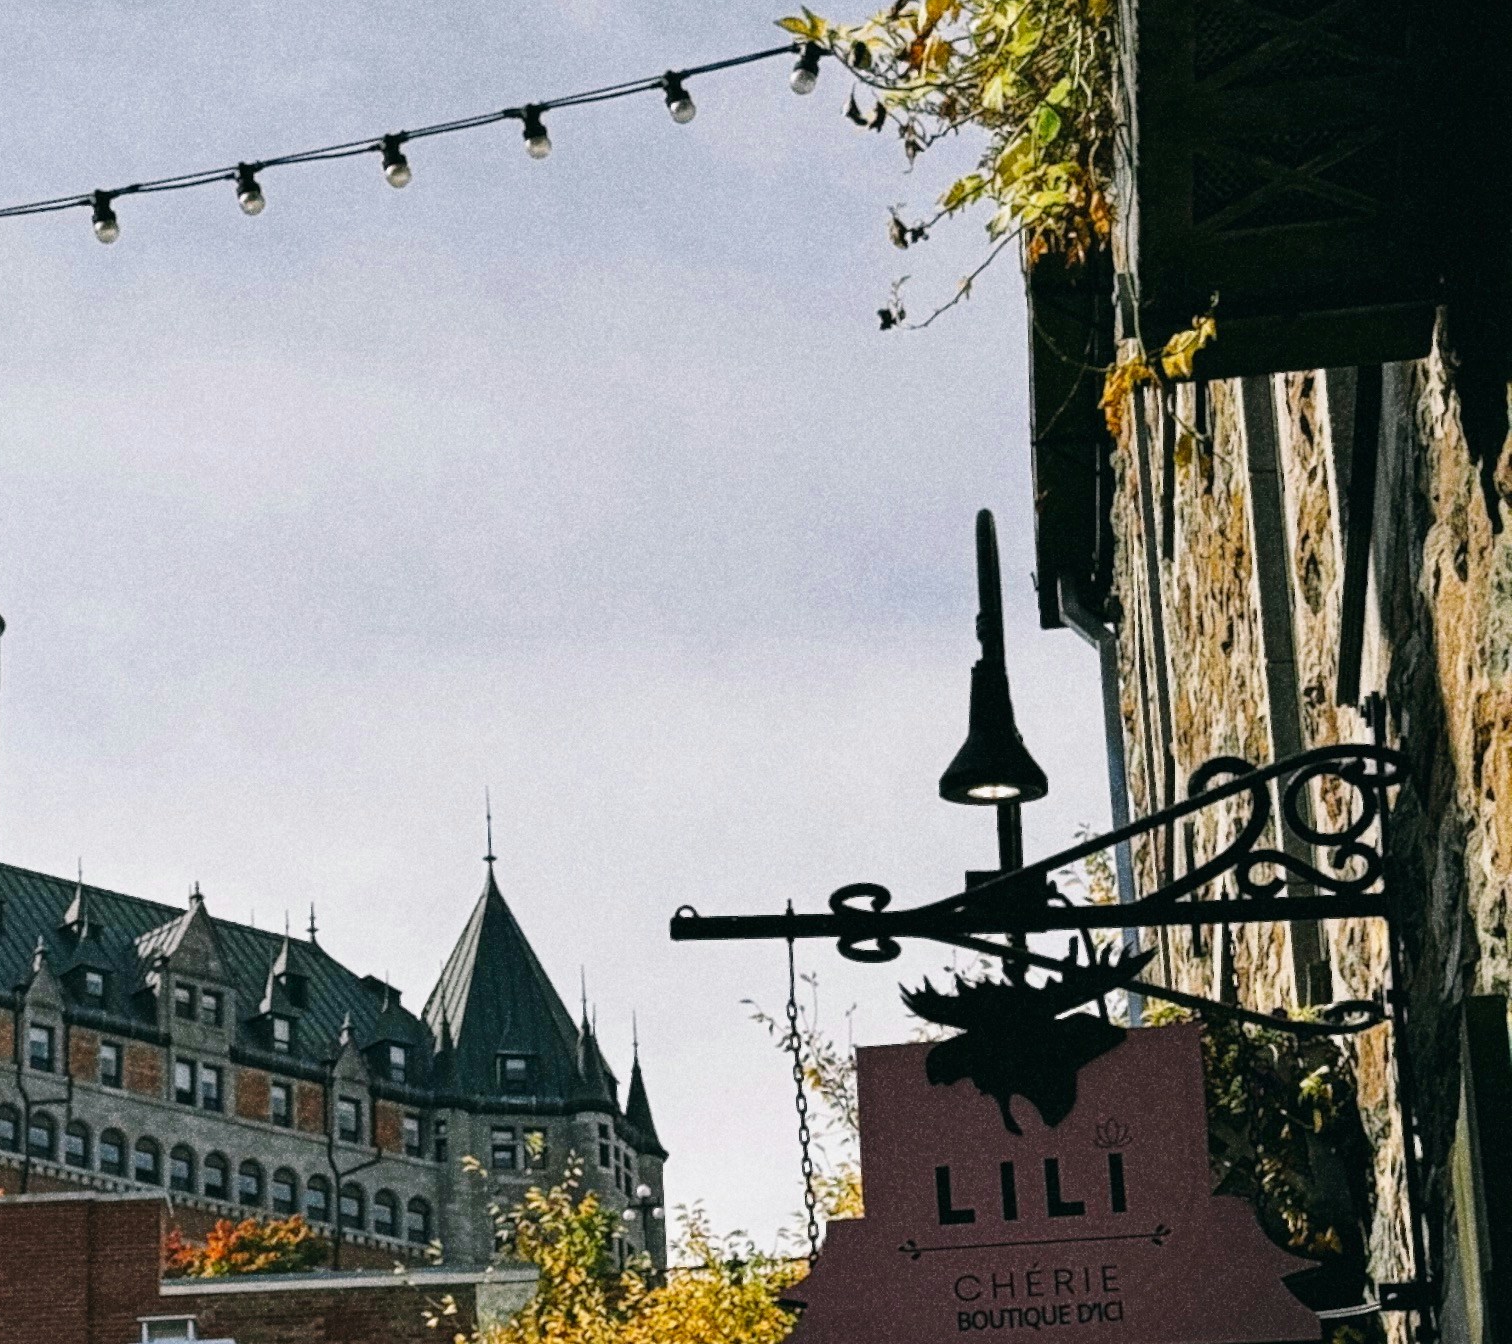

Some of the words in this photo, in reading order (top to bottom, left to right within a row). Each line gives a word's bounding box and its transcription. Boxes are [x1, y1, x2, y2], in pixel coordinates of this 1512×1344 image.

[935, 1153, 1127, 1224] LILI
[954, 1262, 1120, 1302] CHÉRIE
[958, 1303, 1071, 1331] BOUTIQUE
[1077, 1299, 1124, 1324] D'ICI
